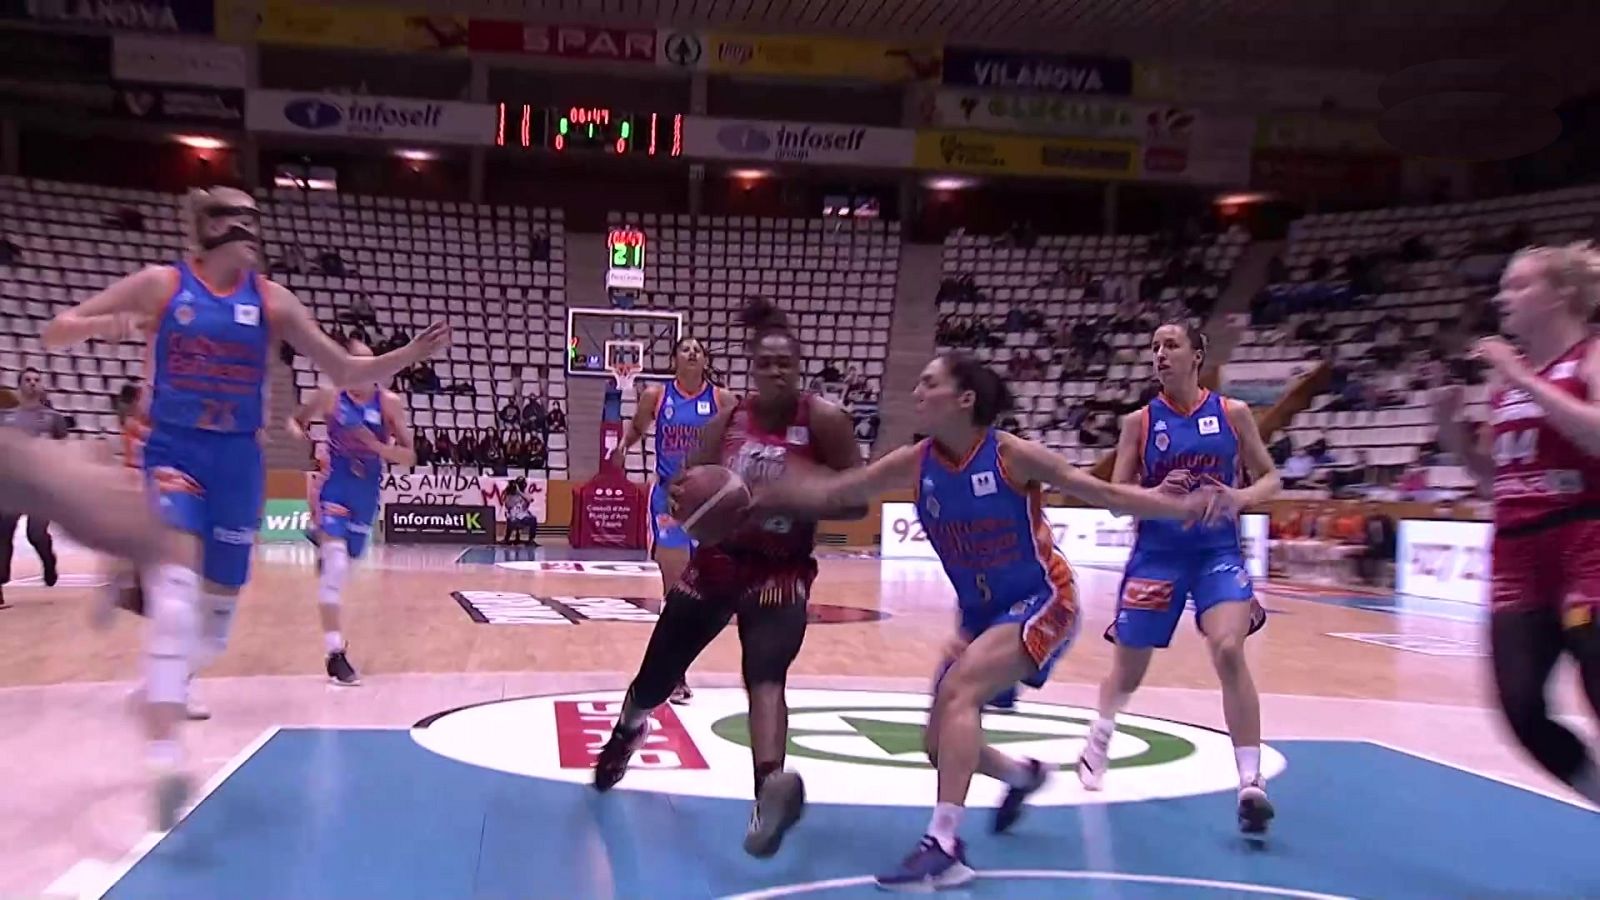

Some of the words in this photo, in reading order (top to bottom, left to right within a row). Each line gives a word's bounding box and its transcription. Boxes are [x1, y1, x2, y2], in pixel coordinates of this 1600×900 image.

[523, 26, 654, 59] SPAR
[973, 60, 1105, 92] VILANOVA
[348, 103, 442, 127] infoself
[777, 126, 866, 151] infoself
